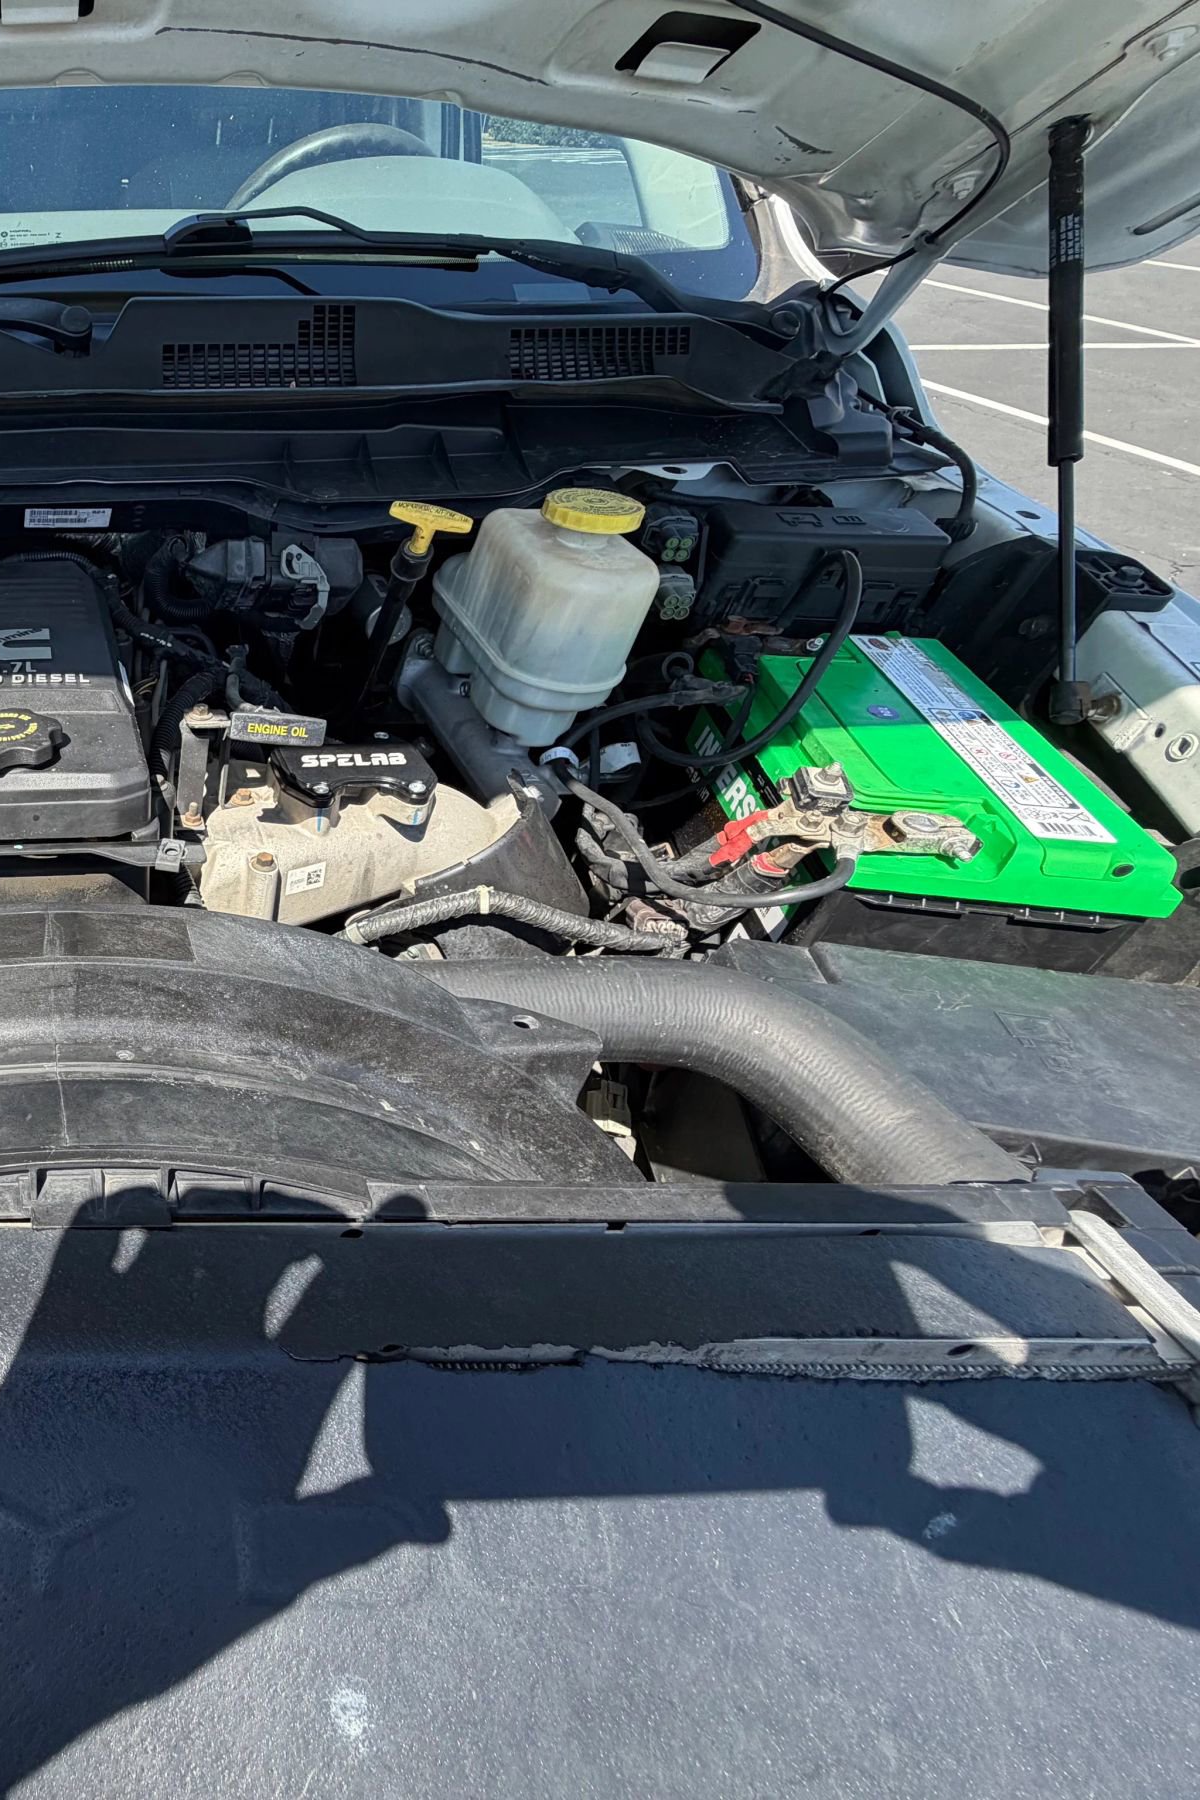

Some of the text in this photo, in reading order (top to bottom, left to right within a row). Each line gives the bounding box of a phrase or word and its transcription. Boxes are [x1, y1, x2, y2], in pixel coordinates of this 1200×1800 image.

[11, 673, 90, 685] DIESEL
[247, 723, 309, 738] ENGINE OIL
[301, 752, 407, 768] SPELAB
